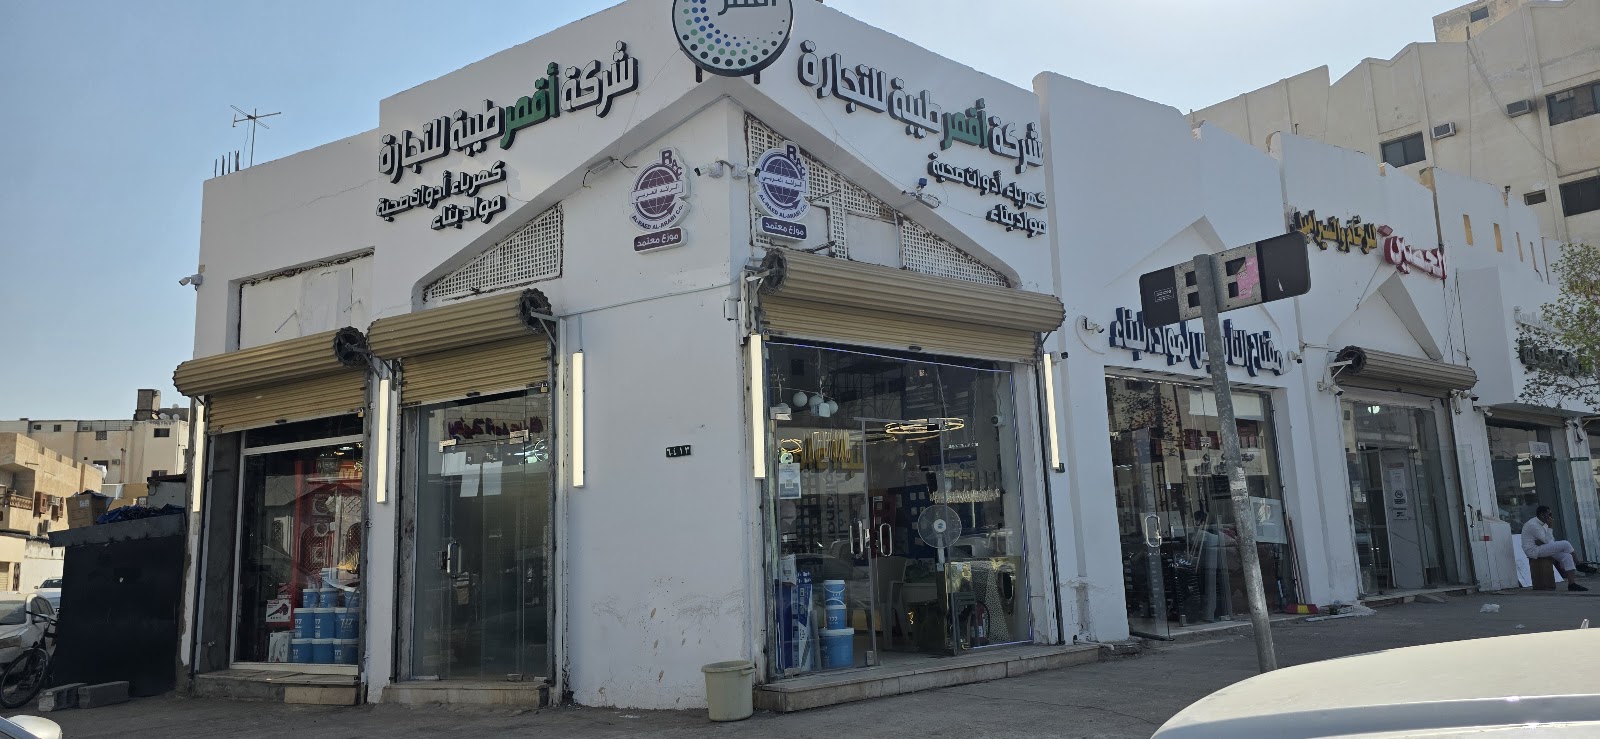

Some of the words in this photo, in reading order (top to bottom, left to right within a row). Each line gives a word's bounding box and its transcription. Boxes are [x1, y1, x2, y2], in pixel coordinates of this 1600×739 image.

[561, 40, 639, 118] شركة
[798, 40, 887, 114] للتجارة
[888, 77, 942, 139] طيبة
[450, 99, 505, 157] طيبة
[379, 116, 450, 184] للتجارة
[987, 115, 1043, 175] شركة
[451, 160, 506, 197] كهرباء
[928, 152, 965, 184] صحية
[963, 168, 1003, 197] أدوات
[410, 170, 452, 209] أدوات
[1002, 182, 1047, 210] كهرباء
[376, 195, 411, 222] صحية
[431, 204, 464, 230] بناء
[461, 195, 506, 224] مواد
[986, 204, 1016, 232] بناء
[661, 233, 679, 244] موزع
[765, 221, 788, 232] معتمد
[788, 225, 805, 236] موزع
[1014, 211, 1047, 238] مواد
[636, 237, 660, 247] معتمد
[1189, 318, 1249, 374] التأسس
[1247, 330, 1285, 377] مفتاح
